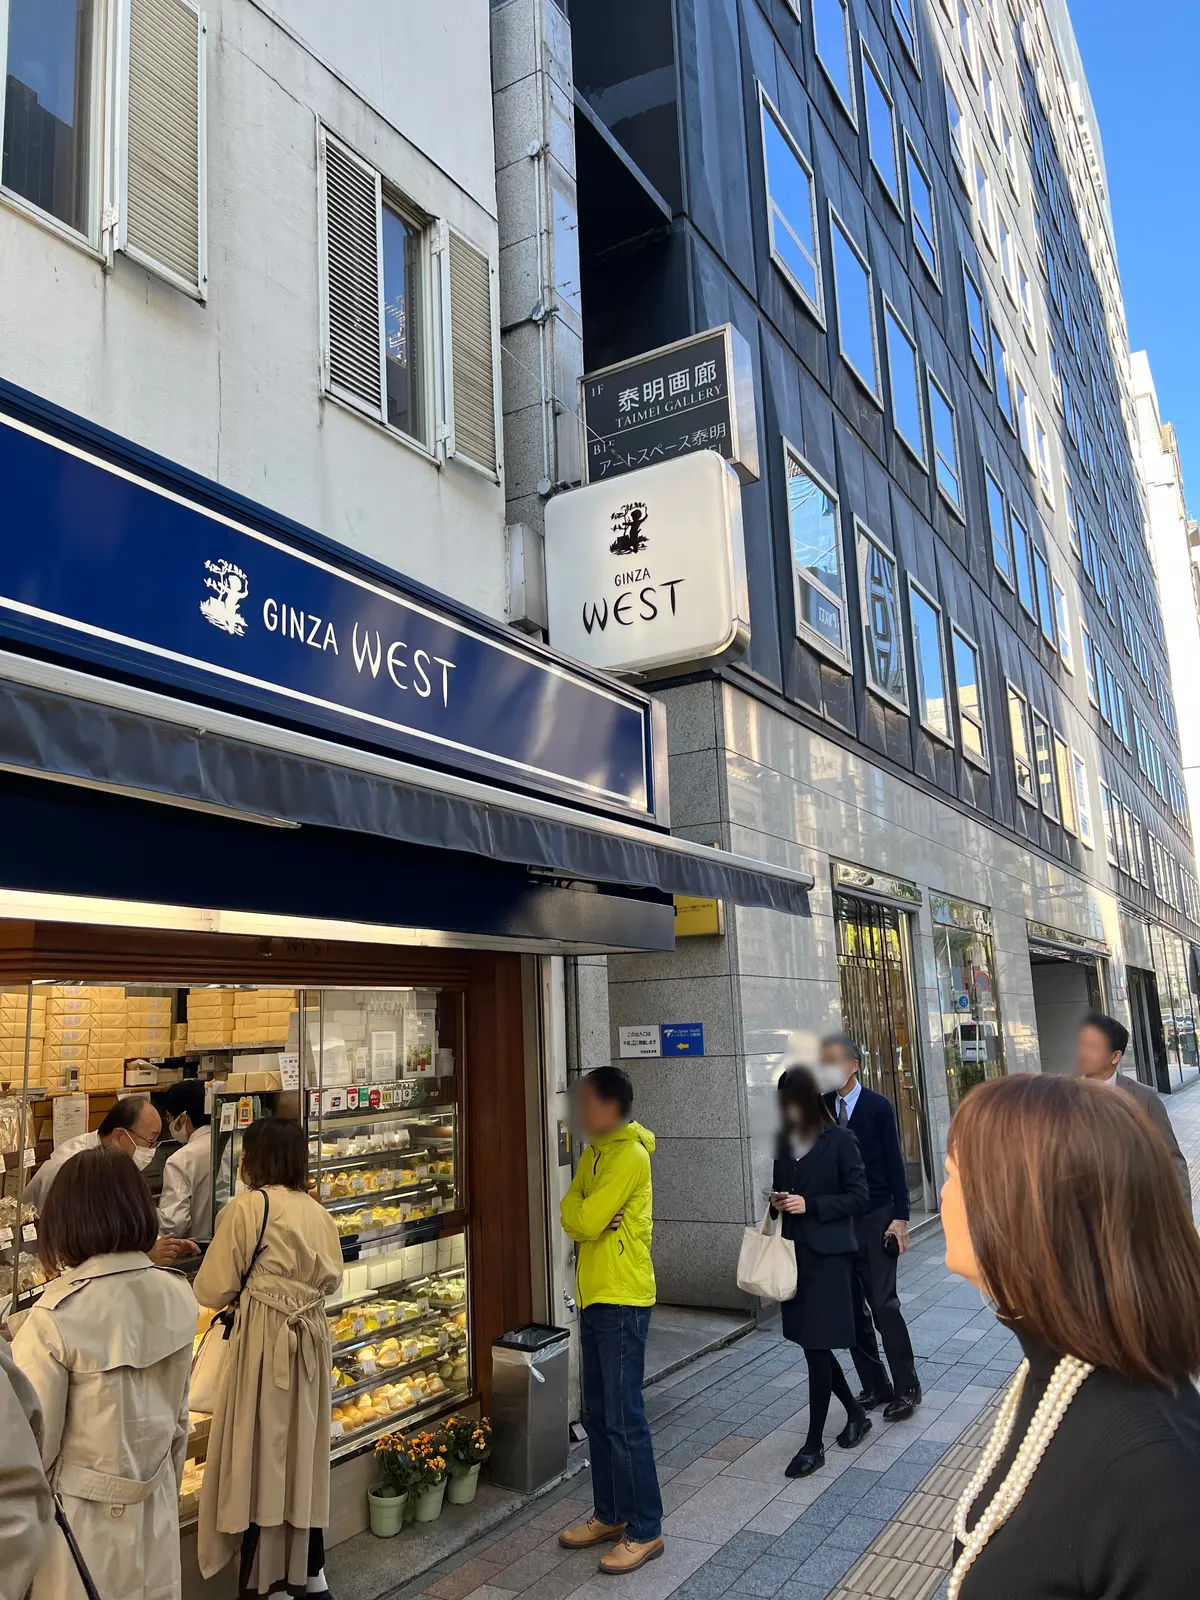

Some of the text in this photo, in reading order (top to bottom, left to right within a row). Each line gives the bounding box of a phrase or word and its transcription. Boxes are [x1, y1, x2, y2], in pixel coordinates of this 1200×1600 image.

[591, 383, 604, 397] 1F
[615, 383, 723, 428] TAIMEI GALLERY
[618, 359, 717, 413] 泰明画廊
[599, 422, 727, 476] アートスペース泰明
[614, 567, 651, 587] GINZA
[582, 578, 686, 635] WEST
[263, 598, 457, 708] GINZA WEST
